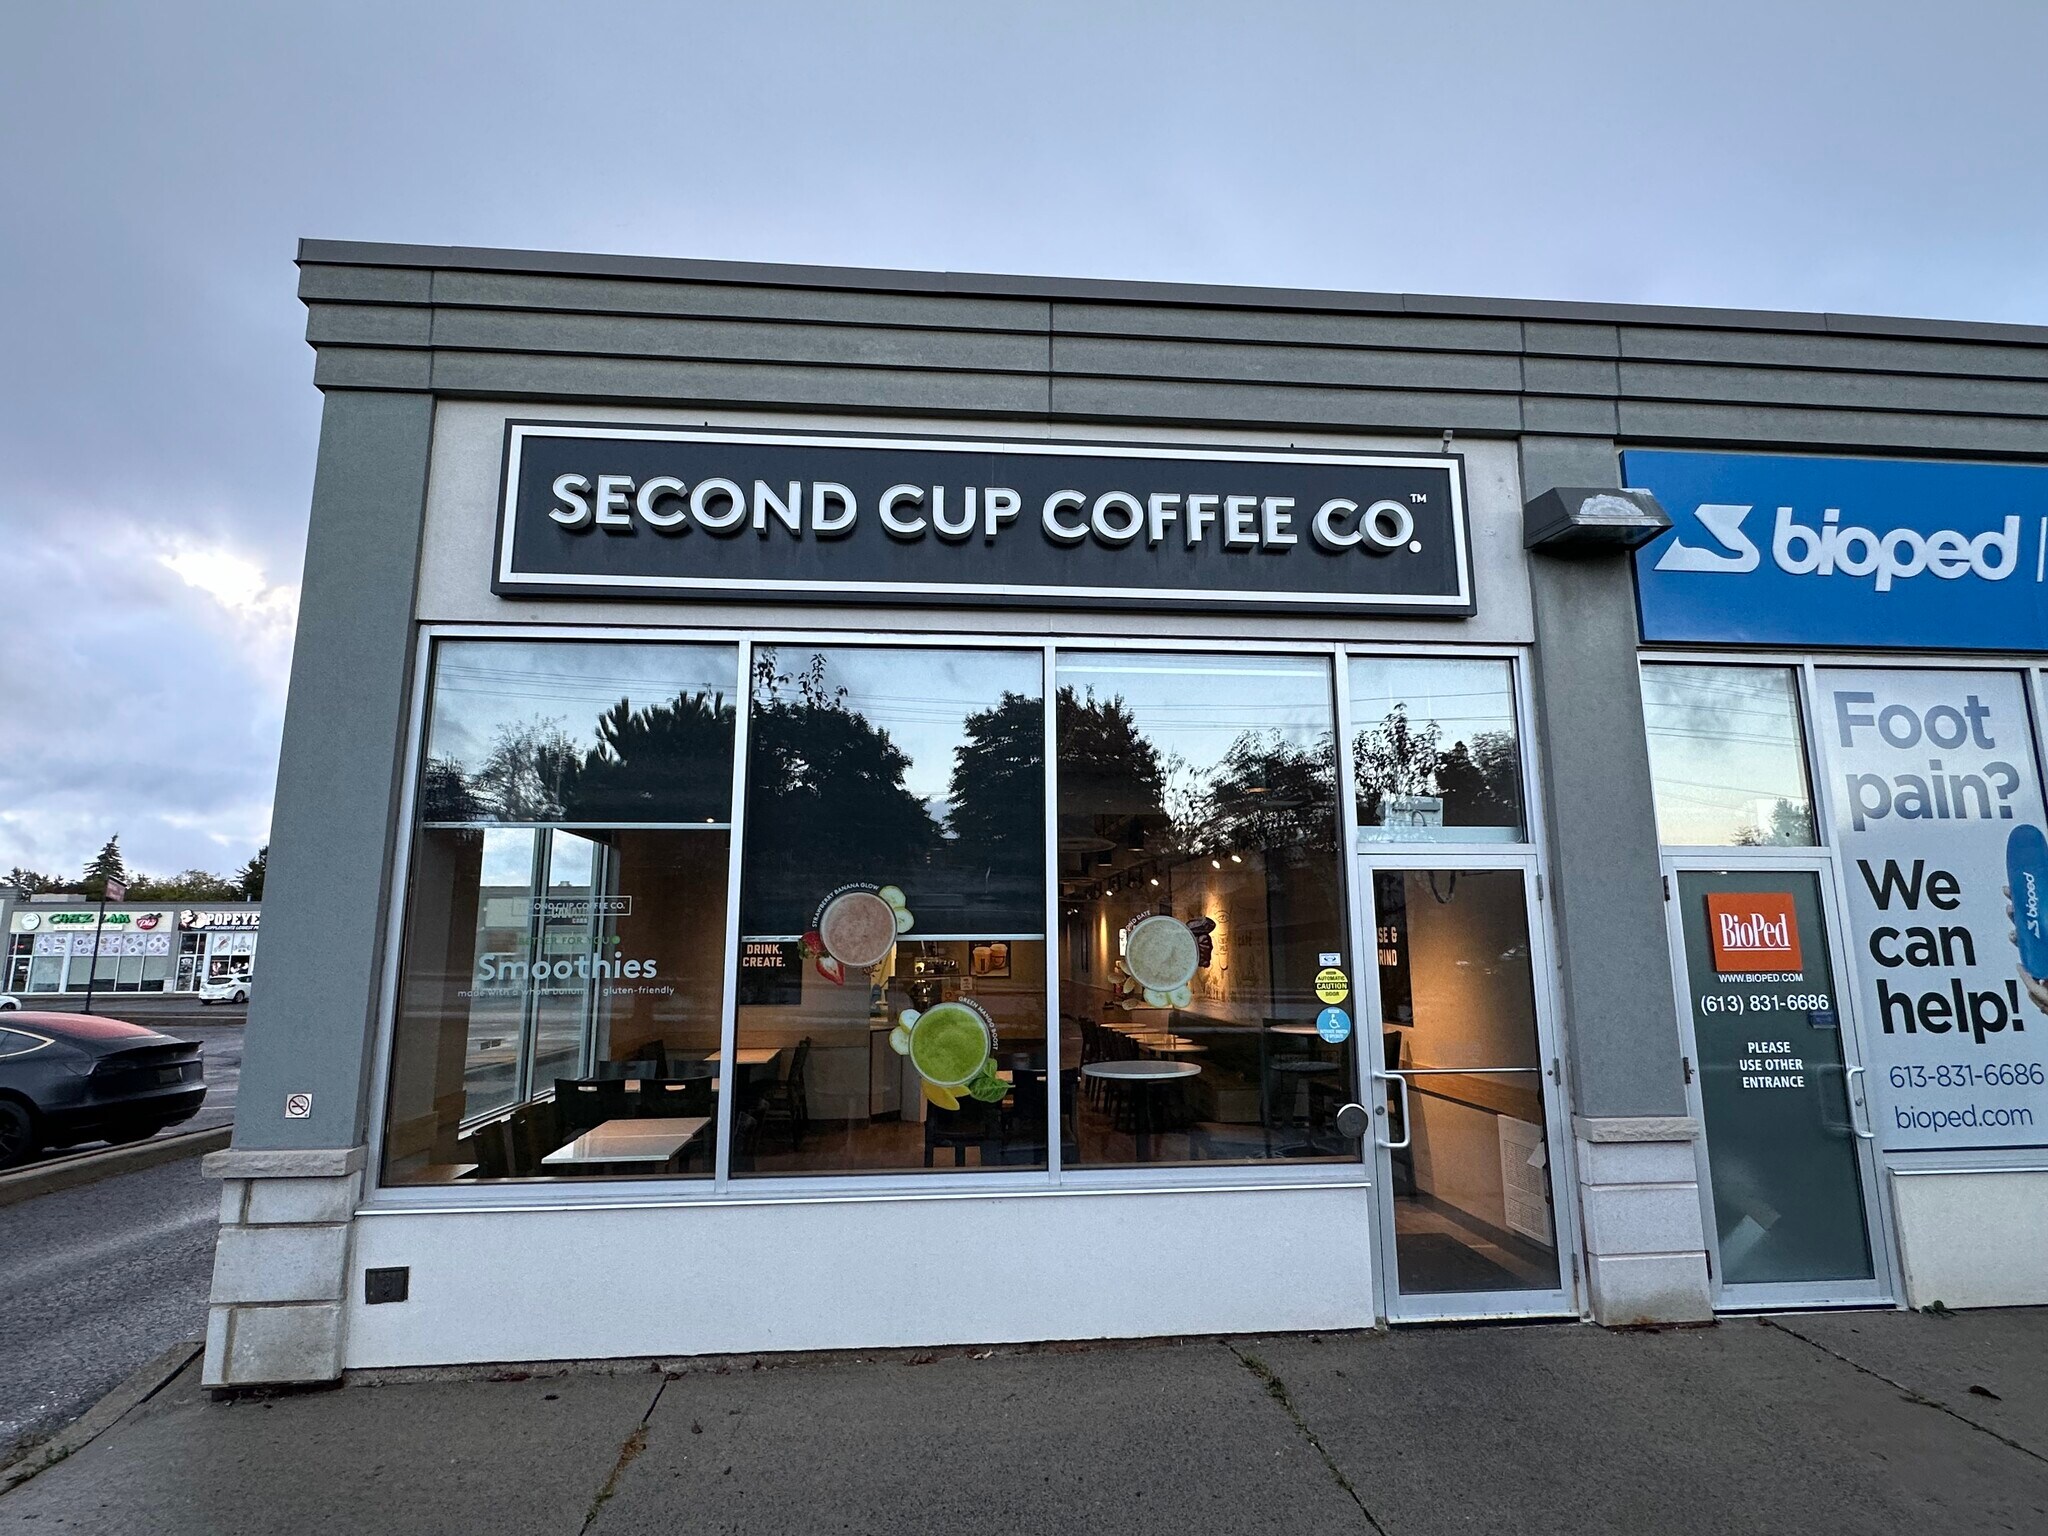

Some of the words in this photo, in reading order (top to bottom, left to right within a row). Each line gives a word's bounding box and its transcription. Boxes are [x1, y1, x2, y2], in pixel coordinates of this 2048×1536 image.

[548, 473, 858, 537] SECOND
[879, 484, 1021, 541] CUP
[1042, 489, 1298, 549] COFFEE
[1312, 498, 1422, 553] CO.
[1771, 506, 2020, 592] bioped
[1833, 691, 1996, 750] Foot
[1845, 759, 2020, 832] pain?
[1856, 859, 1961, 911] We
[2022, 871, 2039, 918] bioped
[206, 913, 260, 925] POPEYE
[812, 892, 835, 928] STRAWBERRY
[834, 882, 859, 895] BANANA
[860, 882, 879, 890] GLOW
[562, 936, 583, 944] FOR
[585, 936, 609, 945] YOU
[1718, 912, 1791, 948] BioPed
[746, 944, 783, 954] DRINK.
[1869, 925, 1977, 967] can
[476, 951, 657, 981] Smoothies
[742, 957, 786, 967] CREATE.
[603, 985, 674, 997] gluten-friendly
[1718, 973, 1803, 983] WWW.BIOPED.COM
[958, 996, 979, 1008] GREEN
[978, 1006, 995, 1028] MANGO
[1701, 994, 1744, 1017] (613)
[1749, 993, 1829, 1011] 831-6686
[1876, 978, 2025, 1044] help!
[1747, 1041, 1791, 1054] PLEASE
[1739, 1059, 1762, 1071] USE
[1765, 1058, 1804, 1071] OTHER
[1889, 1063, 2045, 1089] 613-831-6686
[1742, 1075, 1805, 1088] ENTRANCE
[1894, 1105, 2034, 1133] bioped.com
